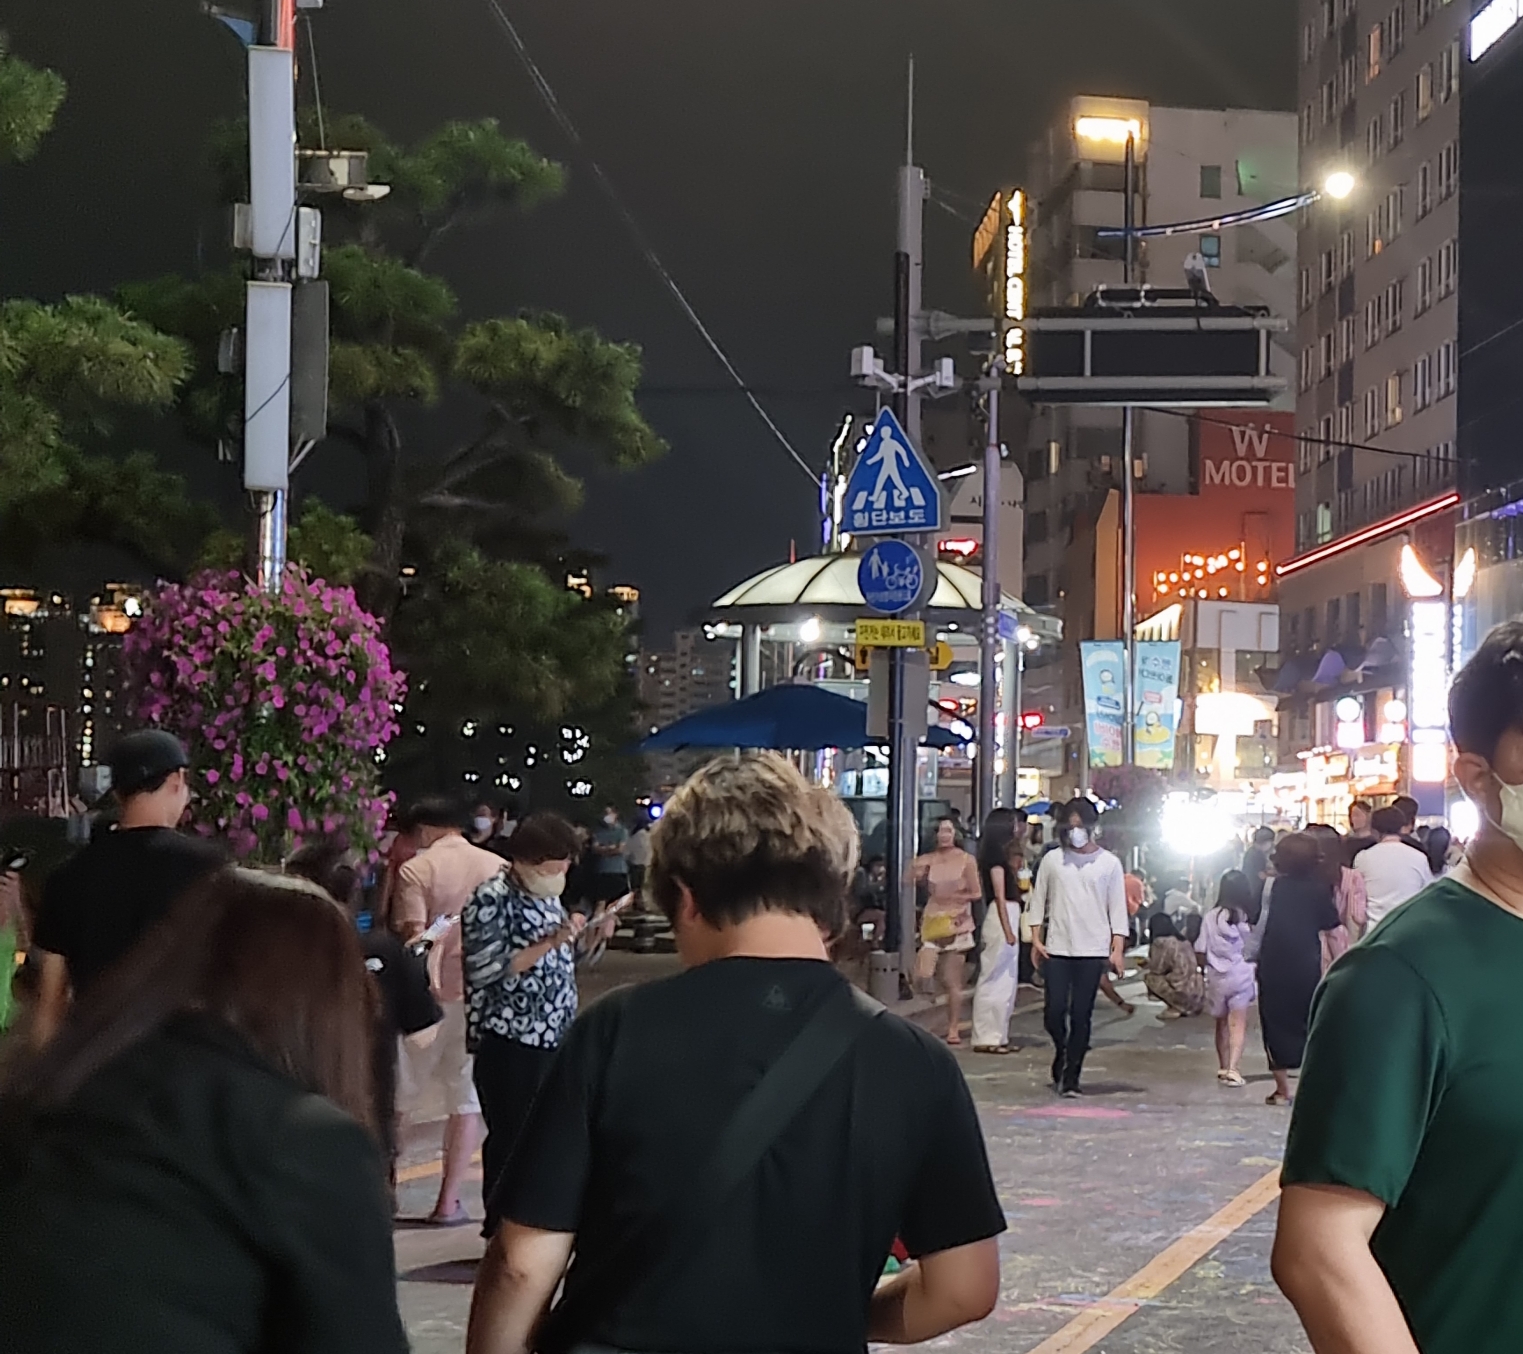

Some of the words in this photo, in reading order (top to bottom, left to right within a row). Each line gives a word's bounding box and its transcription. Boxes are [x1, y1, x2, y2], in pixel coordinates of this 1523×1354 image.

[1007, 225, 1024, 277] HOTEL
[1204, 459, 1295, 489] MOTEL
[853, 508, 927, 527] 횡단보도
